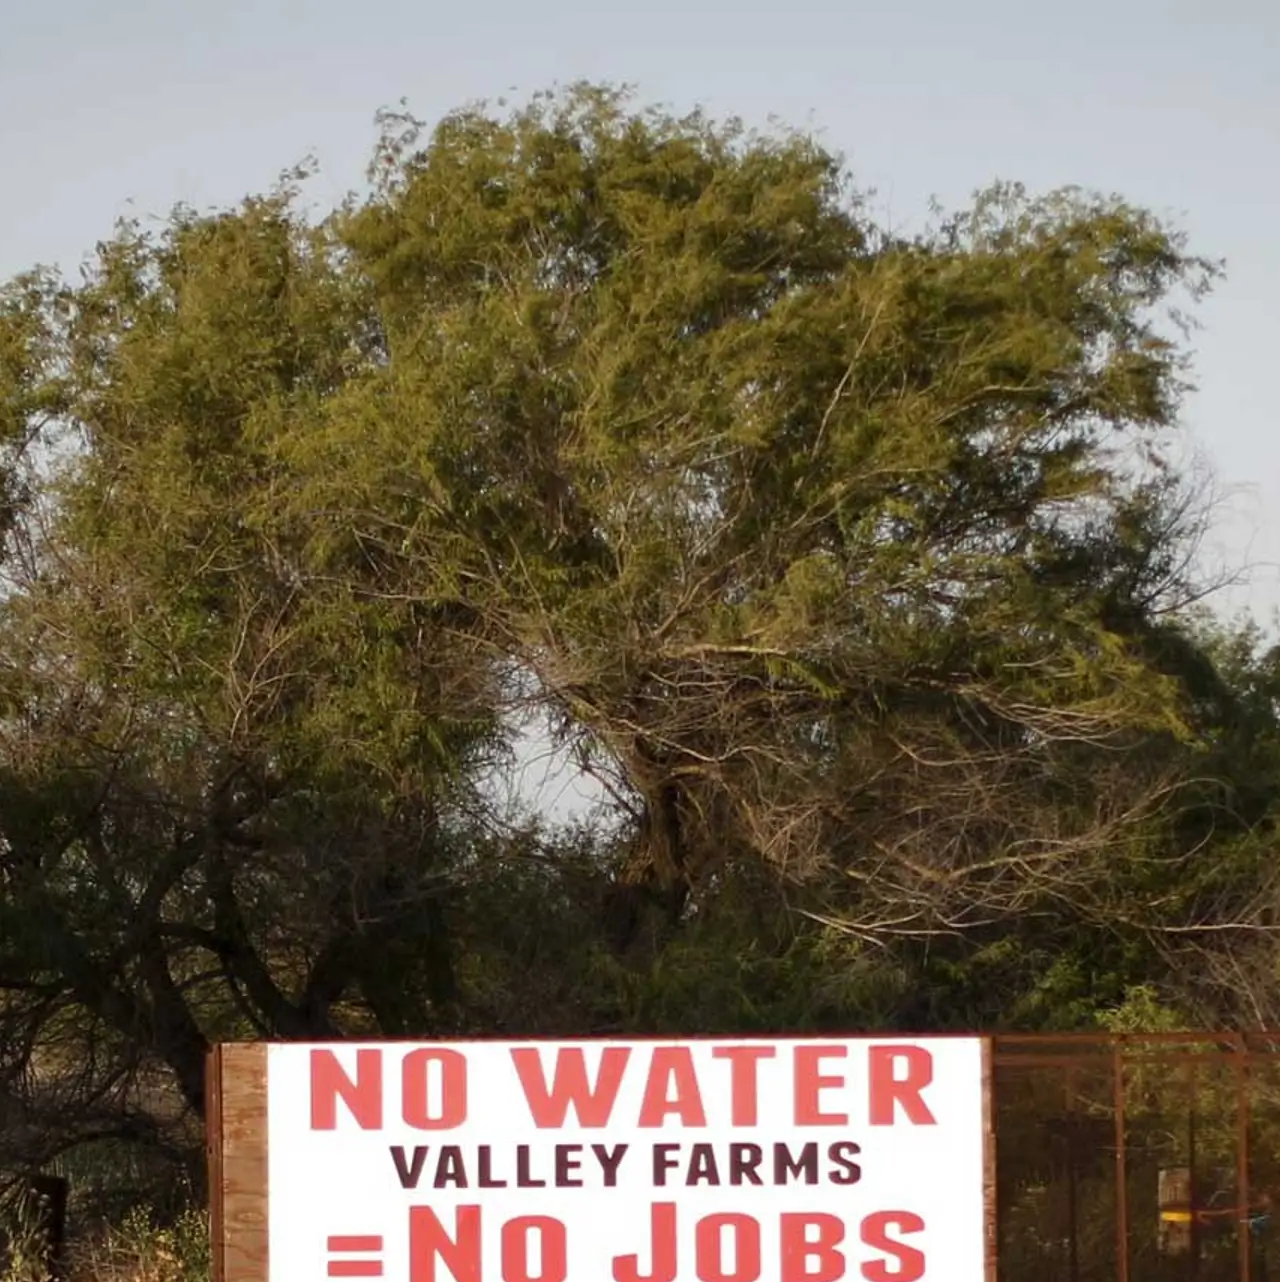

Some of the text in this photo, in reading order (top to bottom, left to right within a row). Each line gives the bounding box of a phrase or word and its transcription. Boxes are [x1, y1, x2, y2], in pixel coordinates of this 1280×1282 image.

[308, 1045, 938, 1130] NO WATER
[389, 1141, 862, 1190] VALLEY FARMS
